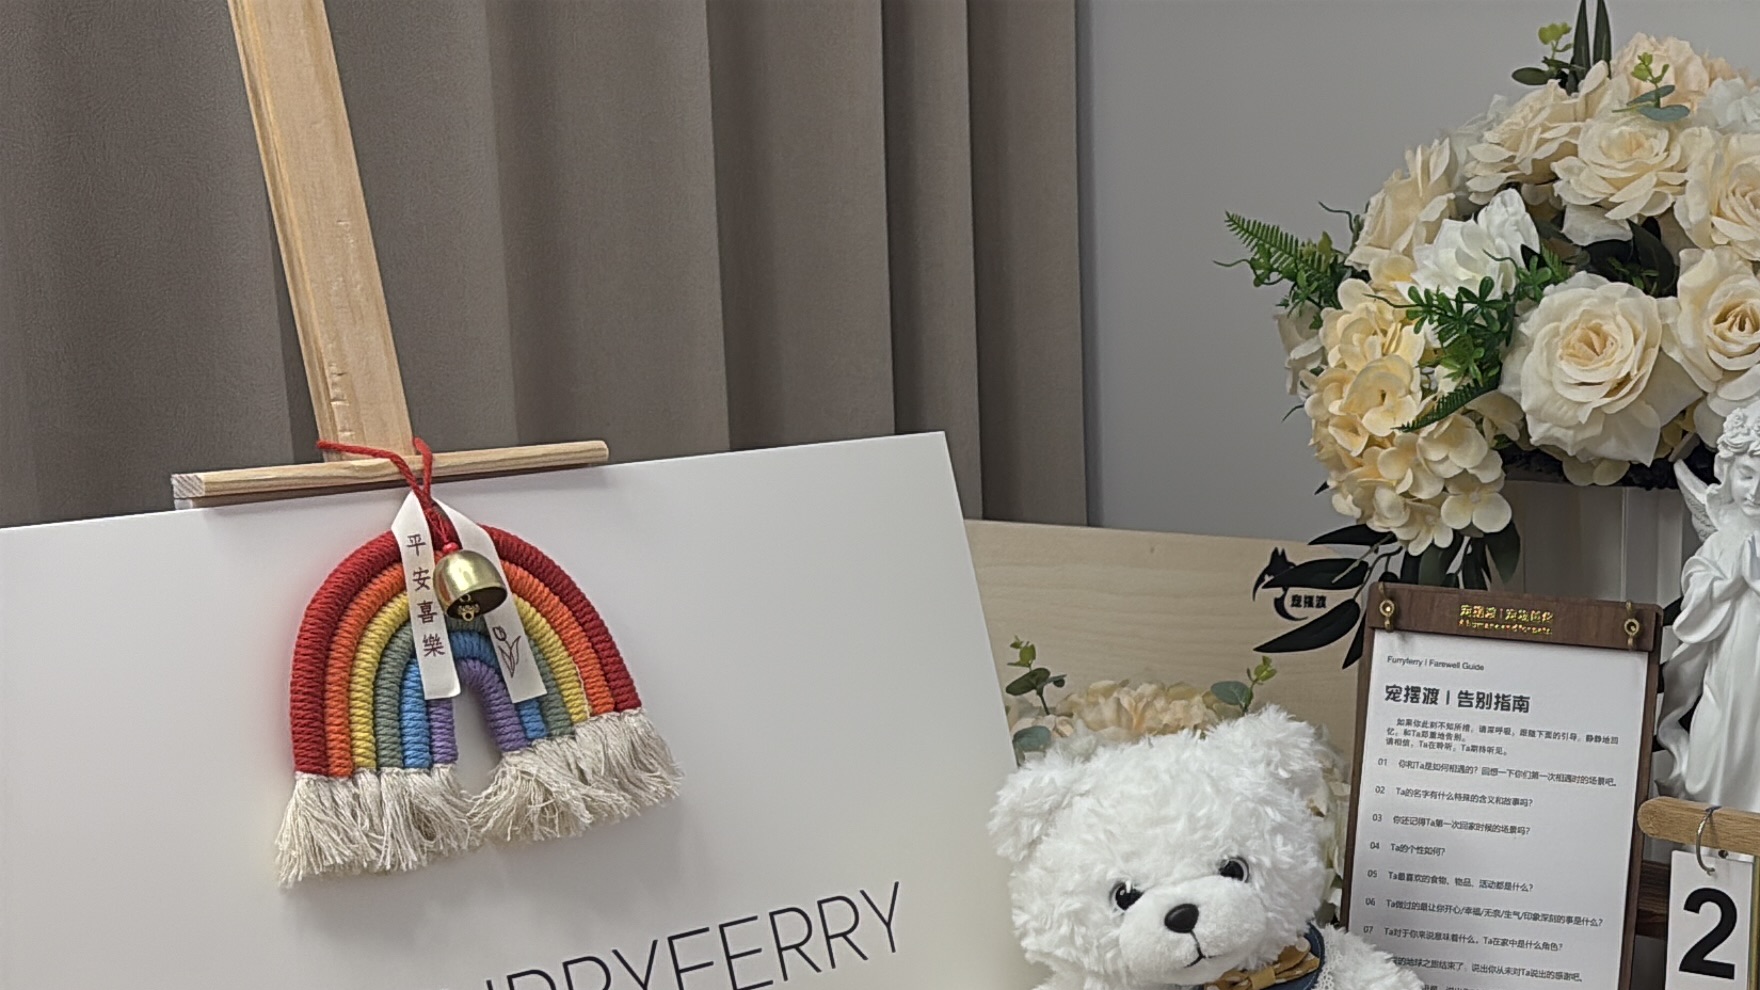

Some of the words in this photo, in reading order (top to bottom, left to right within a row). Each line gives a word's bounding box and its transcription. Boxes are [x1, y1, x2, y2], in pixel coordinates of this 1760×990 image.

[406, 533, 446, 658] 平安喜樂
[1429, 659, 1461, 669] Farewell
[1462, 662, 1485, 671] Guide
[1384, 684, 1440, 706] 宠摆渡
[1457, 690, 1531, 713] 告别指南
[1378, 758, 1388, 766] 01
[1375, 786, 1385, 794] 02
[1372, 814, 1382, 822] 03
[1370, 842, 1380, 850] 04
[1367, 869, 1377, 878] 05
[1365, 898, 1375, 906] 06
[1363, 926, 1373, 934] 07
